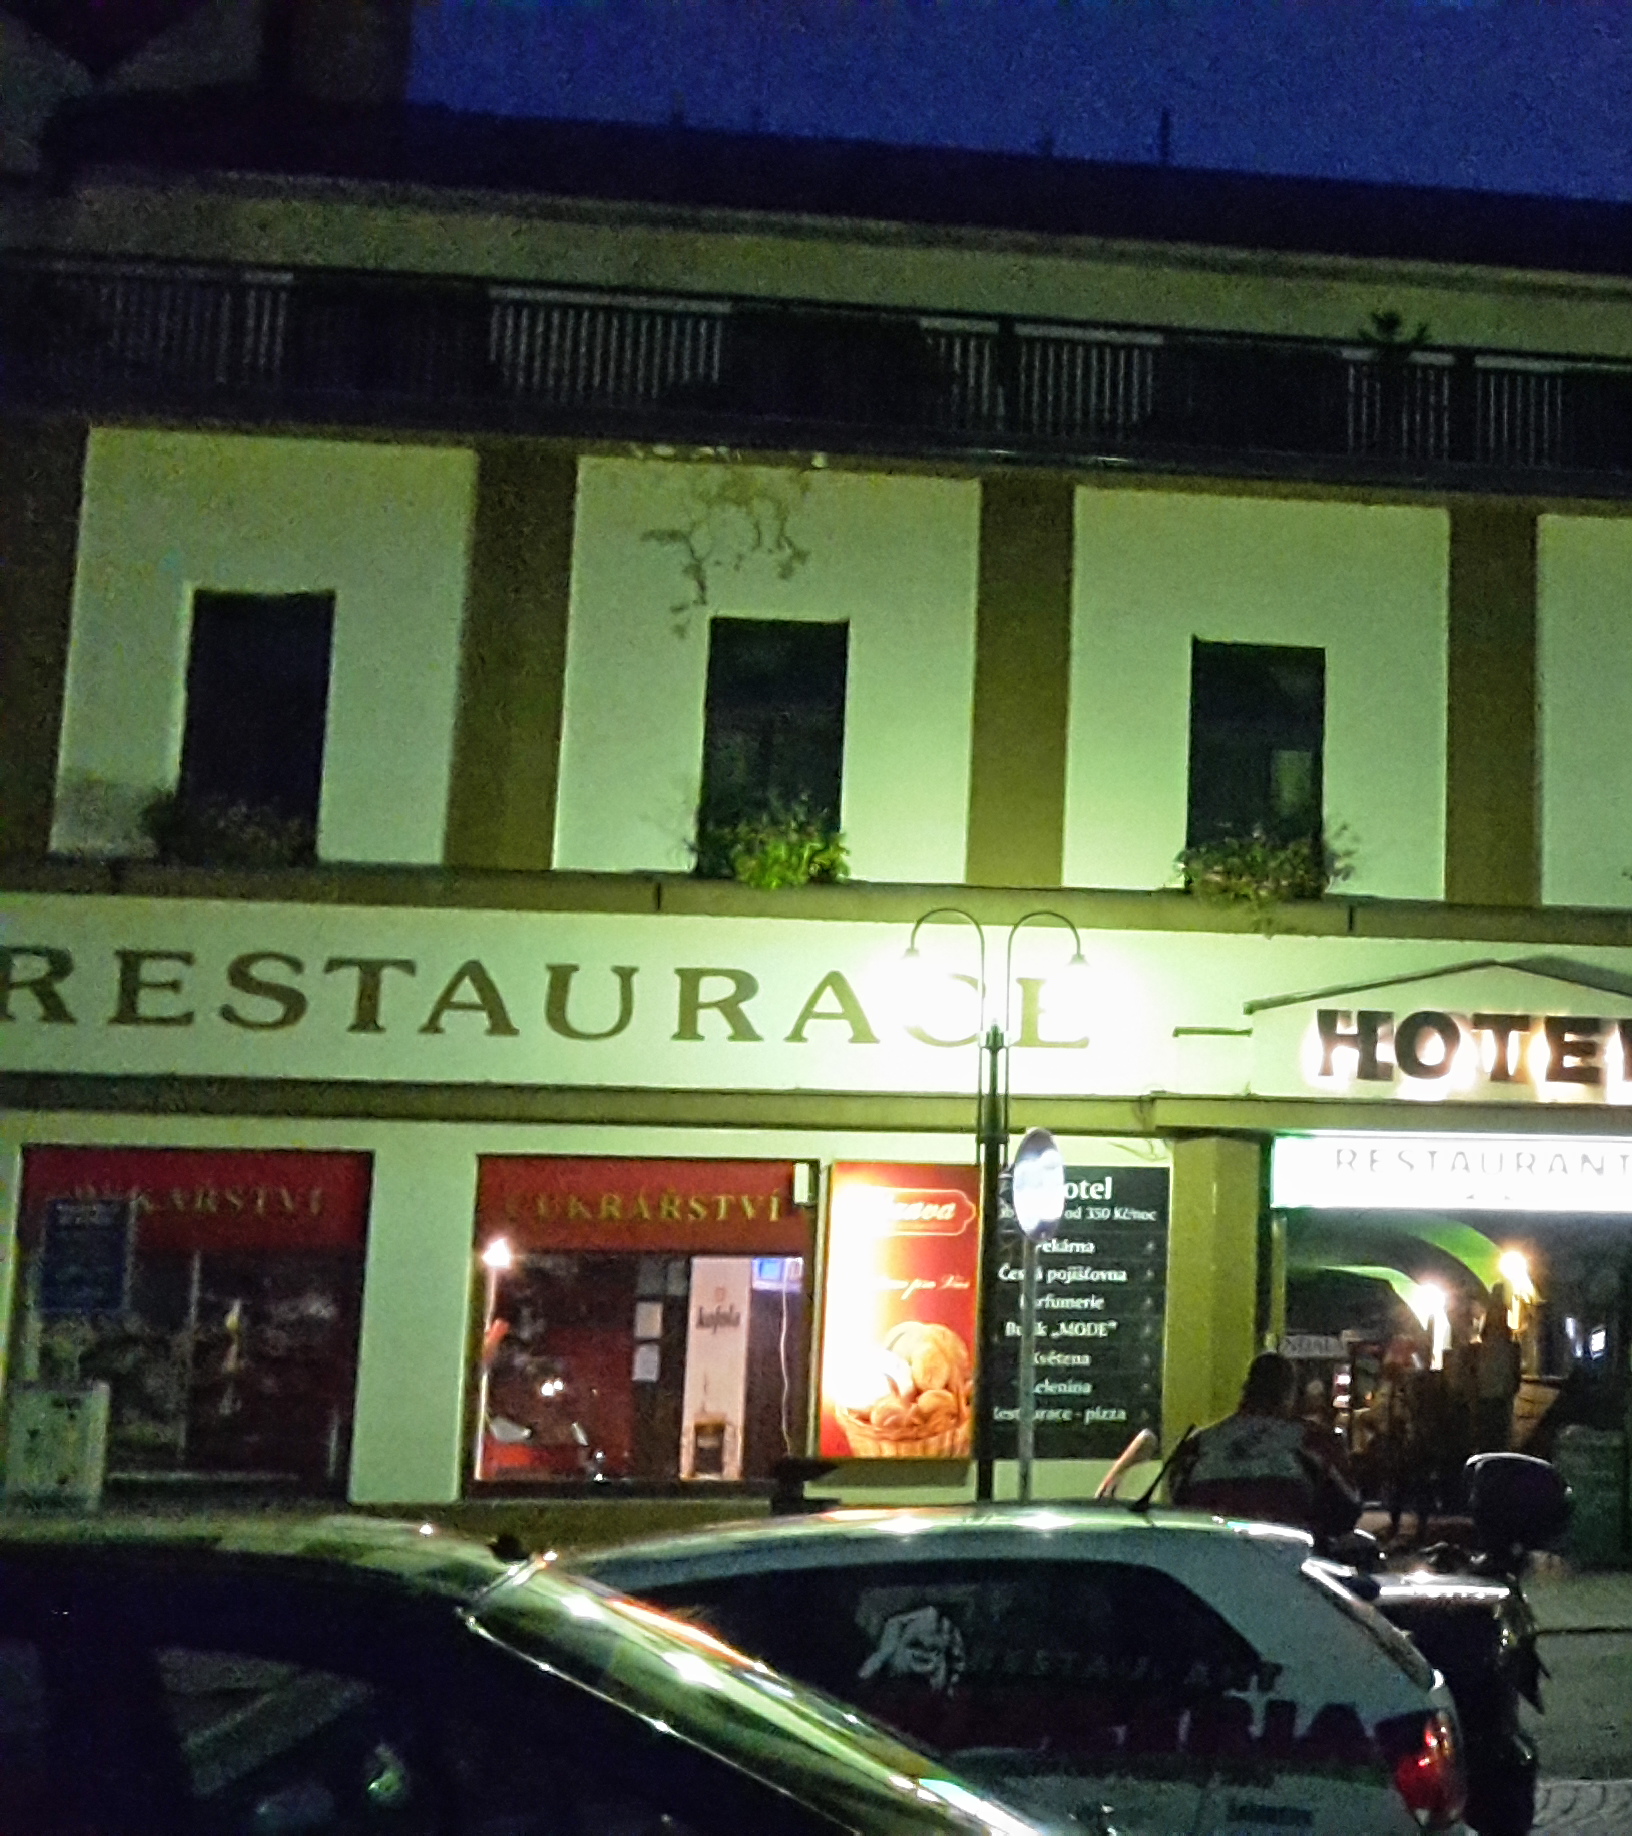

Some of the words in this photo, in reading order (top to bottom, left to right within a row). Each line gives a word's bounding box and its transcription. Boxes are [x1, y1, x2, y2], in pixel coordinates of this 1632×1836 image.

[1336, 1148, 1631, 1176] RESTAURANT
[1063, 1176, 1113, 1200] otel
[1036, 1238, 1095, 1254] ekárna
